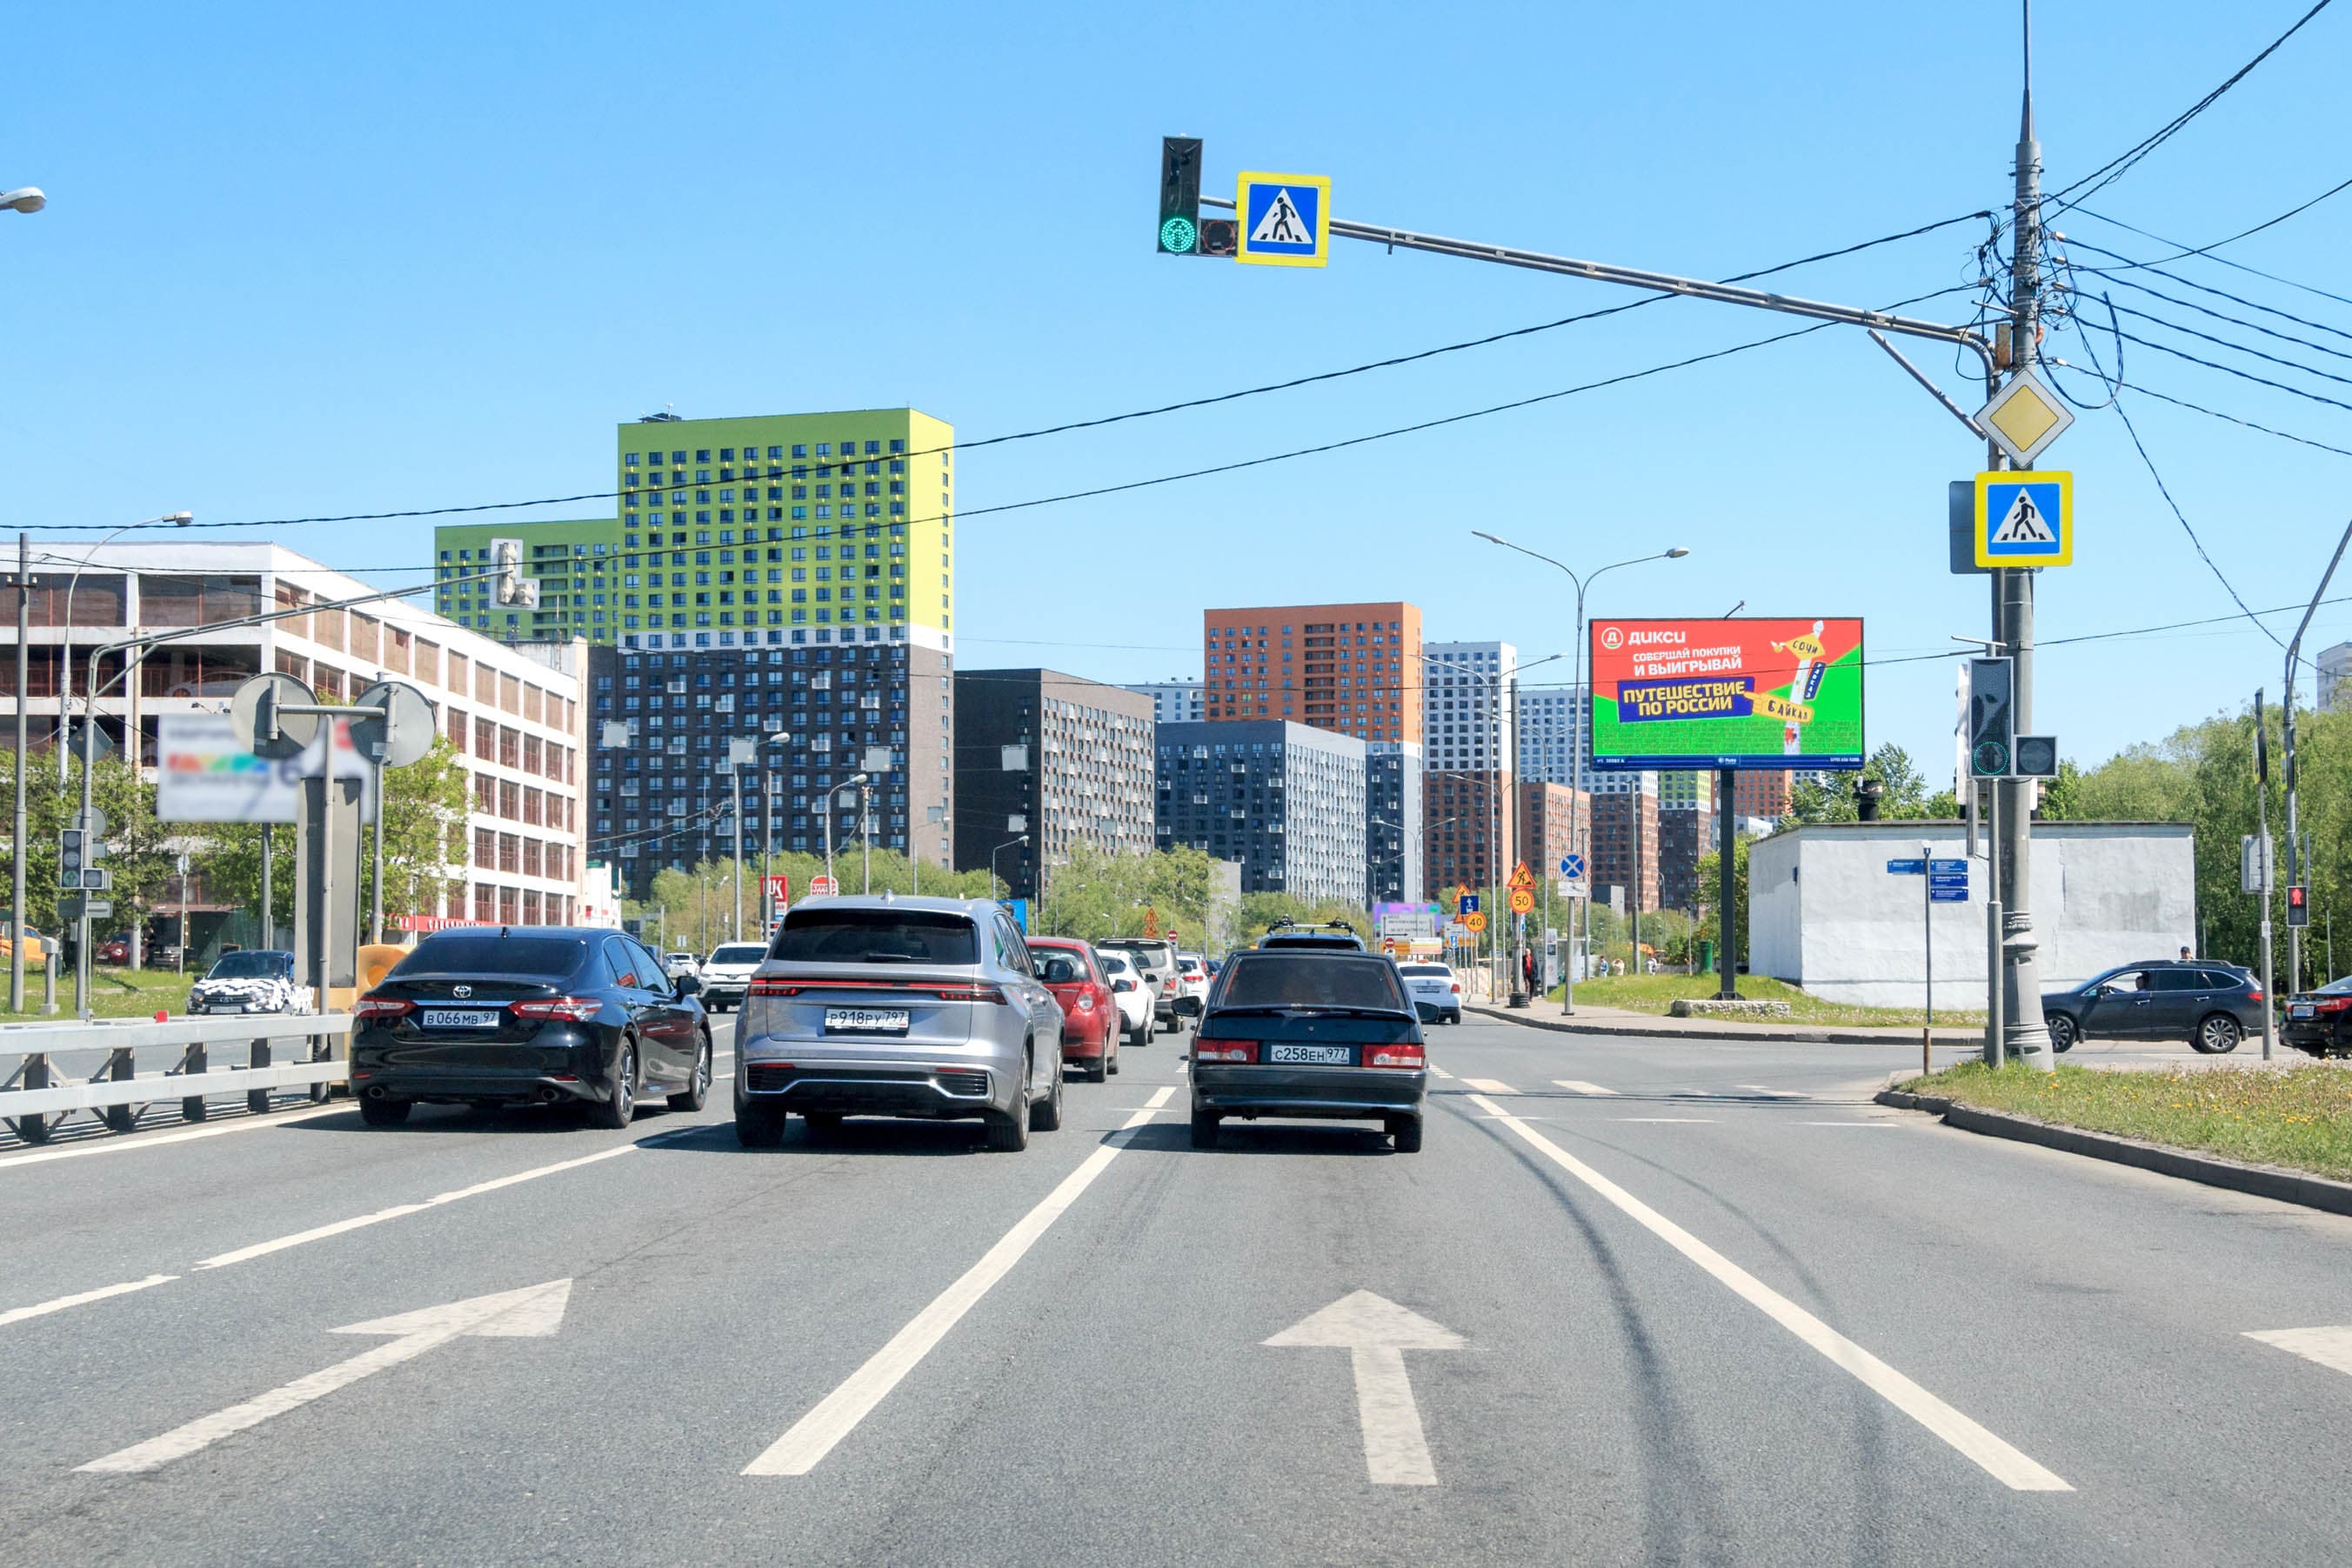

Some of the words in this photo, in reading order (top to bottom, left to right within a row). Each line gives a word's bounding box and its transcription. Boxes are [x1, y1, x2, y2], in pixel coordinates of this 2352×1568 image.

[1628, 631, 1687, 645] ДИКСИ
[1633, 648, 1690, 662] СОВЕРШАЙ
[1692, 646, 1741, 658] ПОКУПКИ
[1793, 640, 1818, 654] СОЧИ
[1634, 664, 1645, 677] И
[1648, 654, 1741, 676] ВЫИГРЫВАЙ
[1623, 681, 1746, 703] ПУТЕШЕСТВИЕ
[1639, 702, 1662, 716] ПО
[1666, 696, 1733, 714] РОССИИ
[1767, 700, 1808, 719] БАЙКАЛ
[1515, 896, 1529, 906] 50
[1469, 917, 1482, 926] 40
[427, 1012, 478, 1024] В066МВ
[484, 1012, 496, 1022] 97
[830, 1011, 881, 1024] Р918РУ
[885, 1011, 905, 1022] 797
[1275, 1048, 1324, 1061] С258ЕН
[1327, 1049, 1346, 1058] 977
